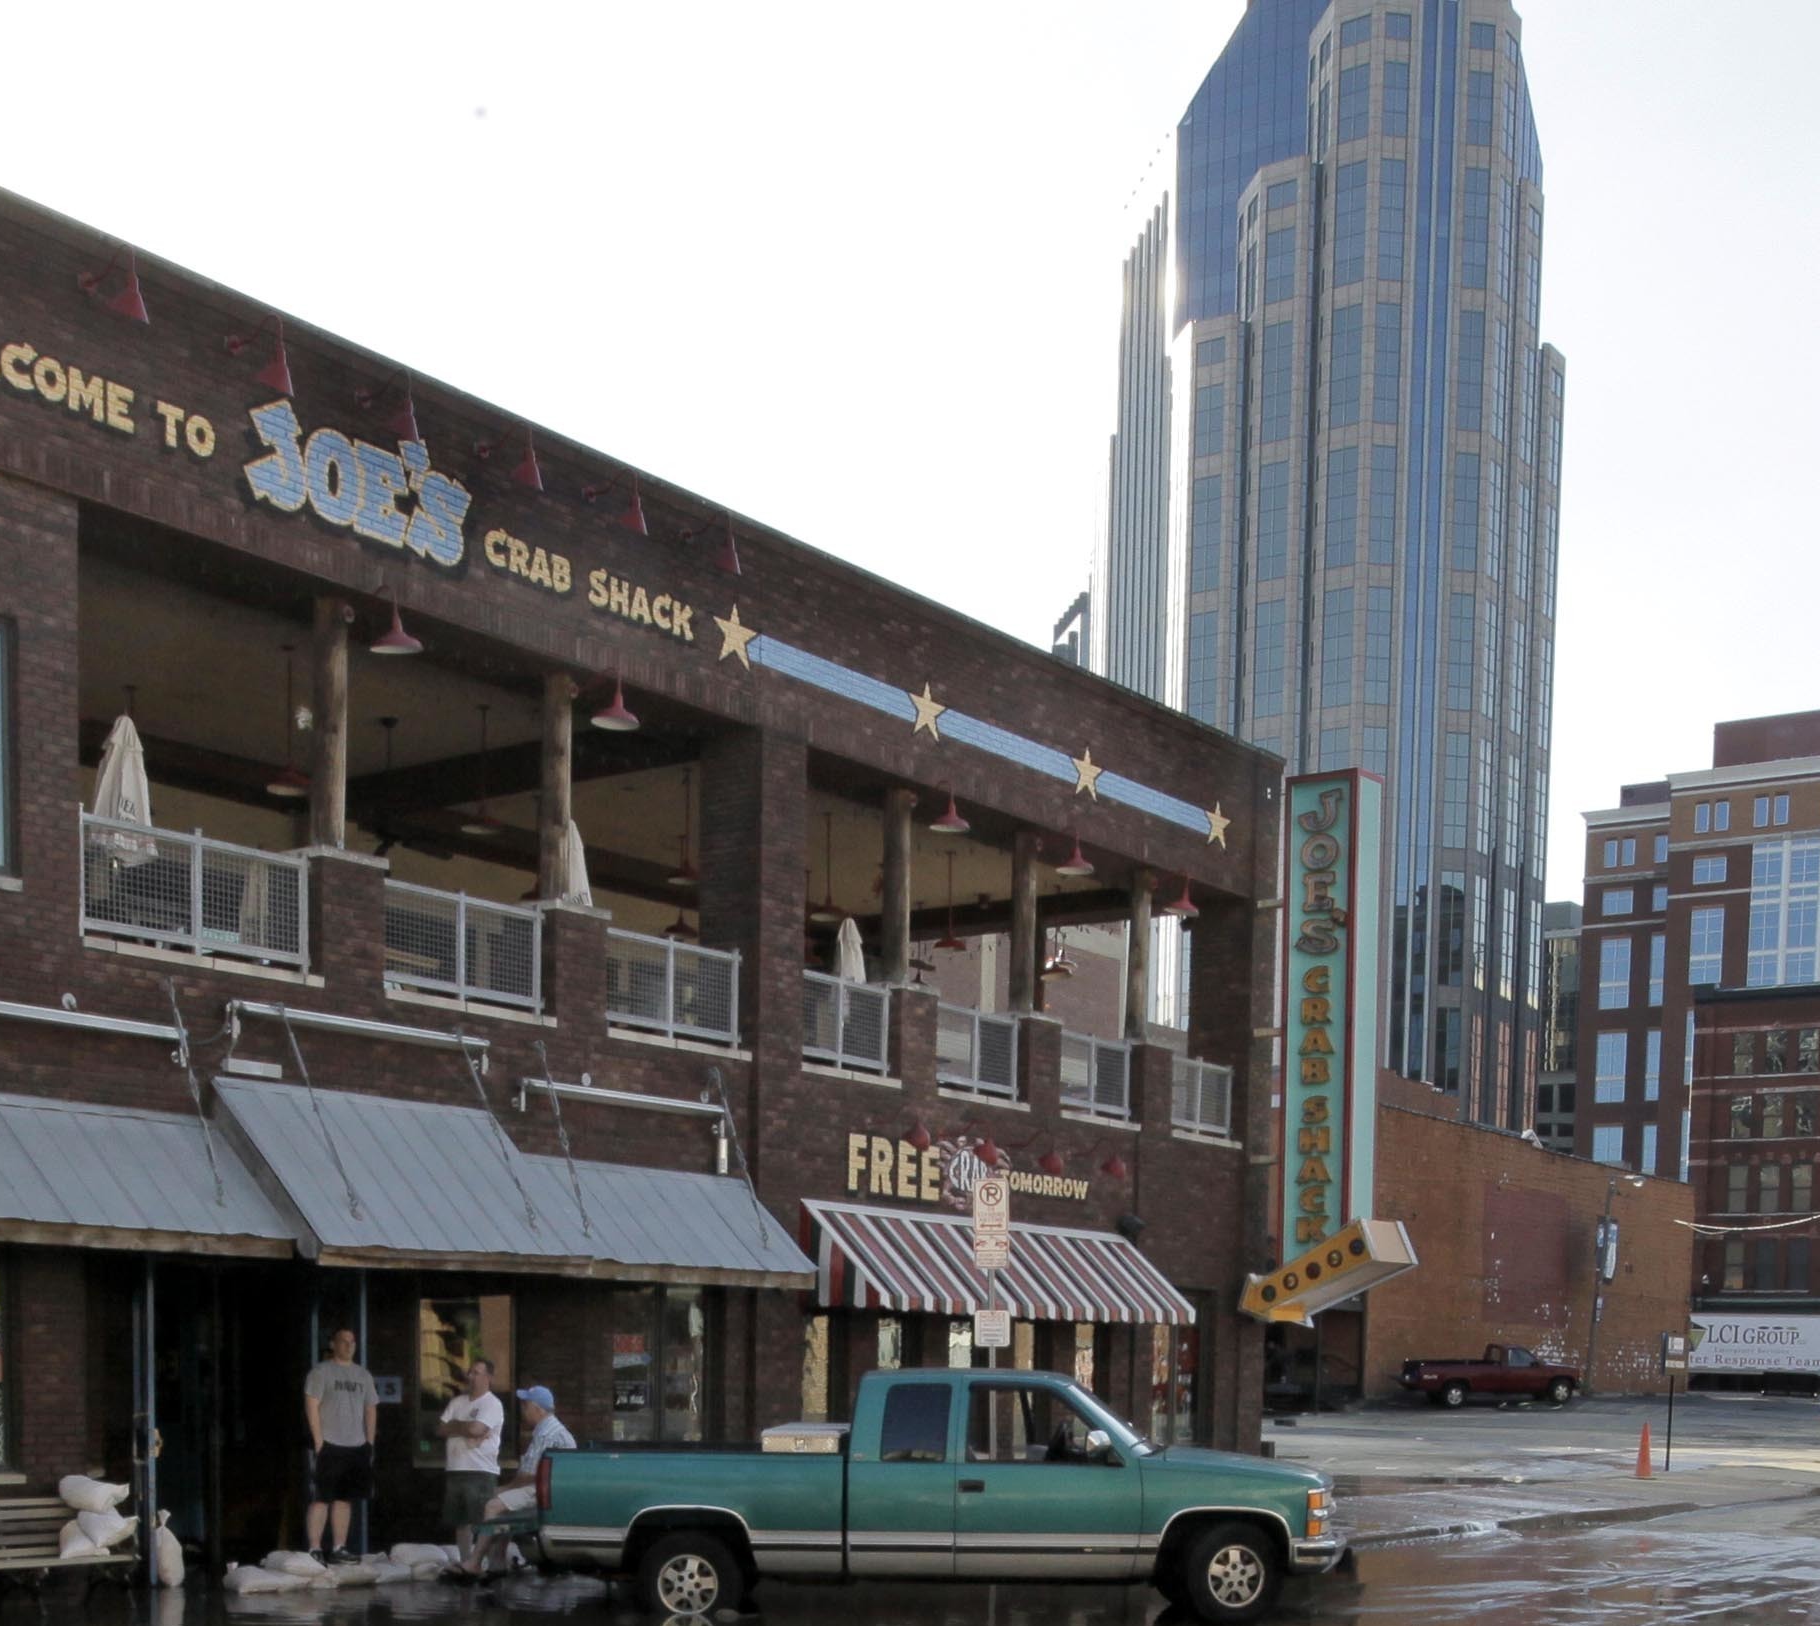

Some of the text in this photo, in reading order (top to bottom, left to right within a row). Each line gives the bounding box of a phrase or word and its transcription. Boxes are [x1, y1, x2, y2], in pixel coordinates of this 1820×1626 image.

[155, 398, 215, 458] TO
[243, 398, 472, 568] JOE'S
[484, 528, 572, 592] CRAB
[586, 567, 695, 641] SHACK
[1296, 787, 1347, 1244] JOE'S CRAB SHACK
[847, 1132, 941, 1201] FREE
[1000, 1168, 1089, 1200] TOMORROW
[1707, 1323, 1739, 1344] LCI
[1743, 1327, 1801, 1345] GROUP
[1714, 1354, 1781, 1367] Response
